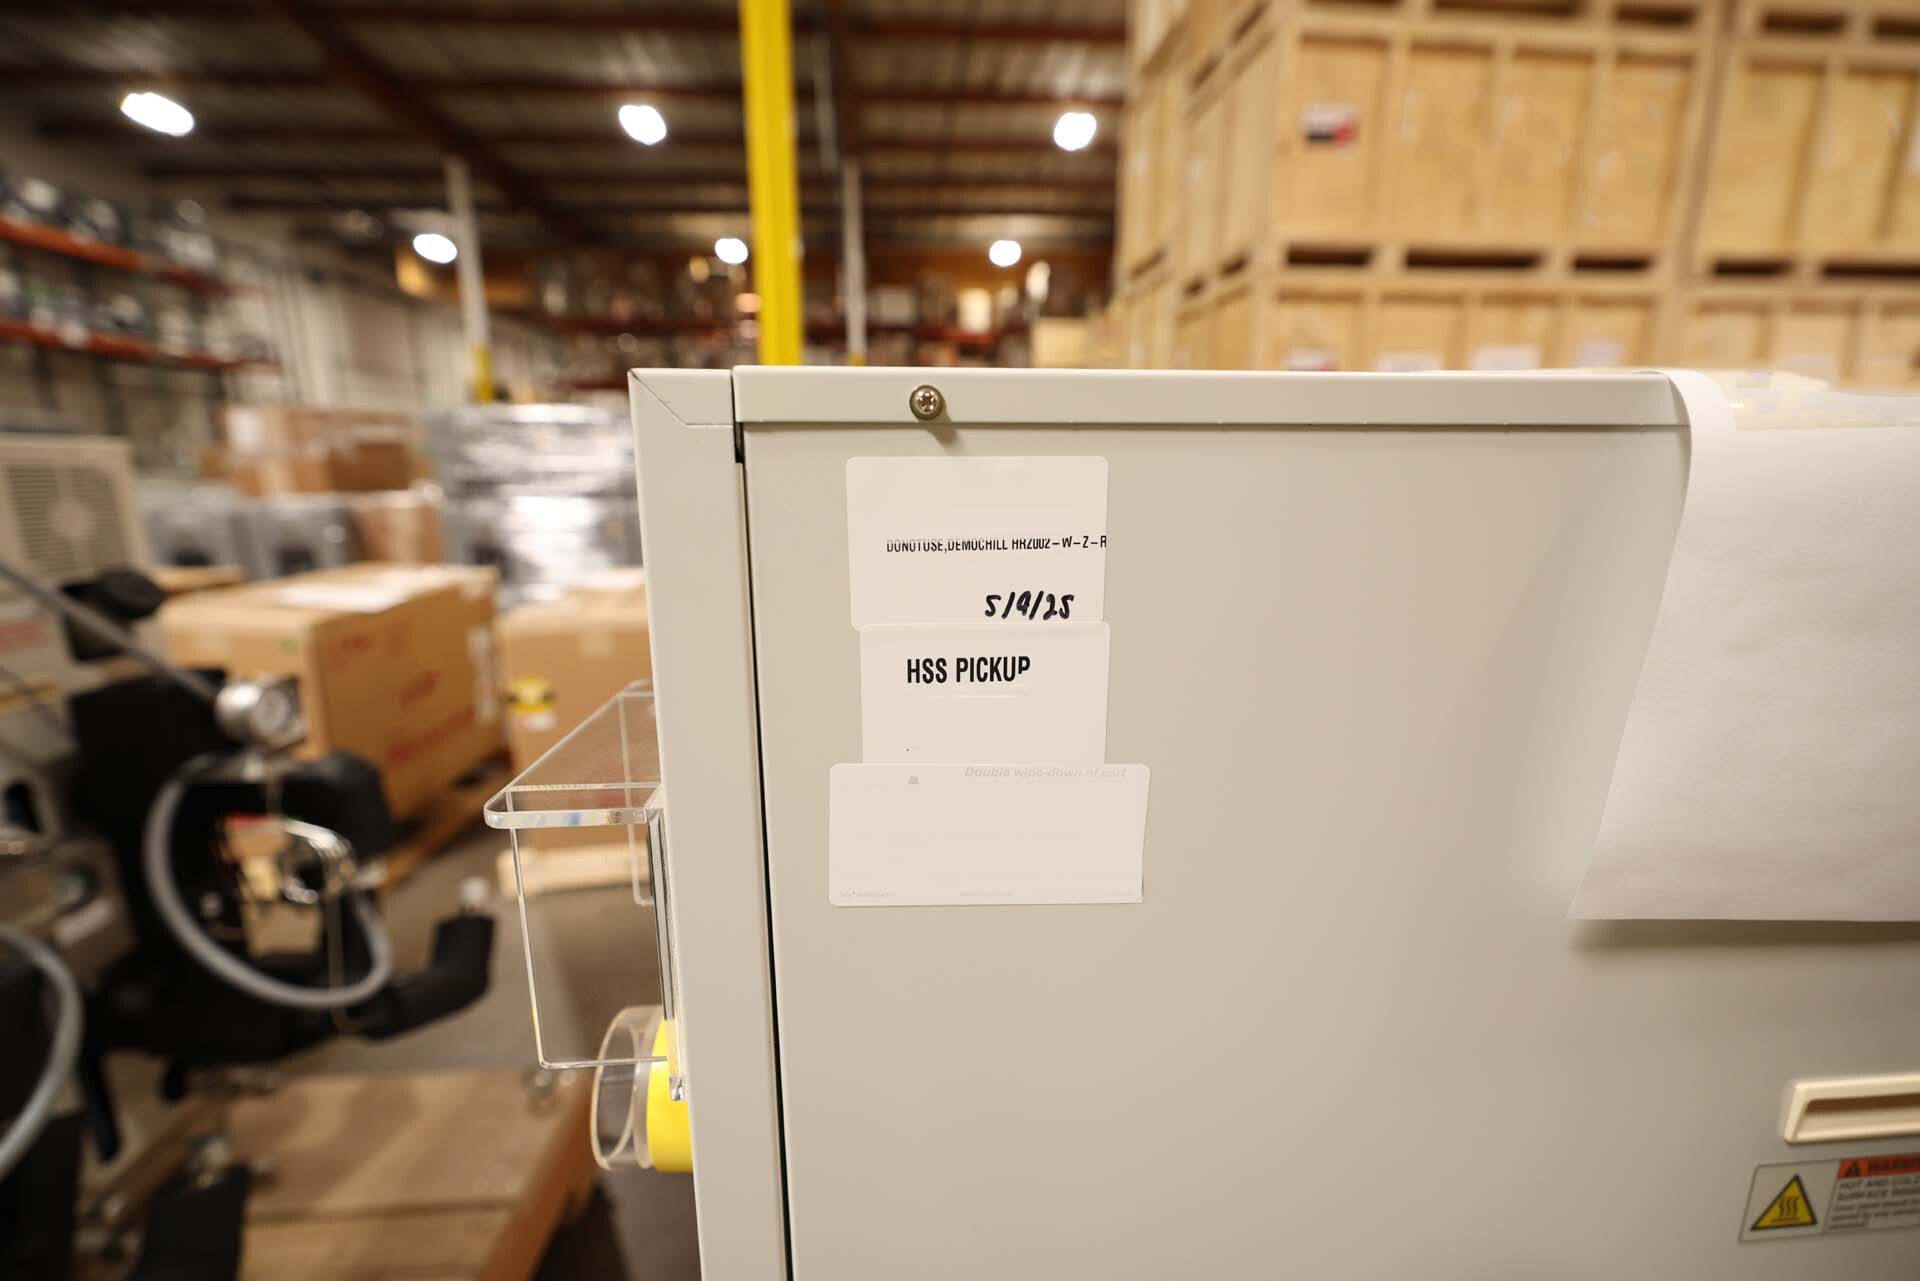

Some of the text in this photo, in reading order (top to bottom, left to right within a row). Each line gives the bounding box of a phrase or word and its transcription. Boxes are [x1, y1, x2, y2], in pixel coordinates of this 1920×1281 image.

[984, 590, 1075, 620] 5/9/25
[907, 656, 1031, 684] HSS PICKUP
[964, 766, 1010, 777] Double
